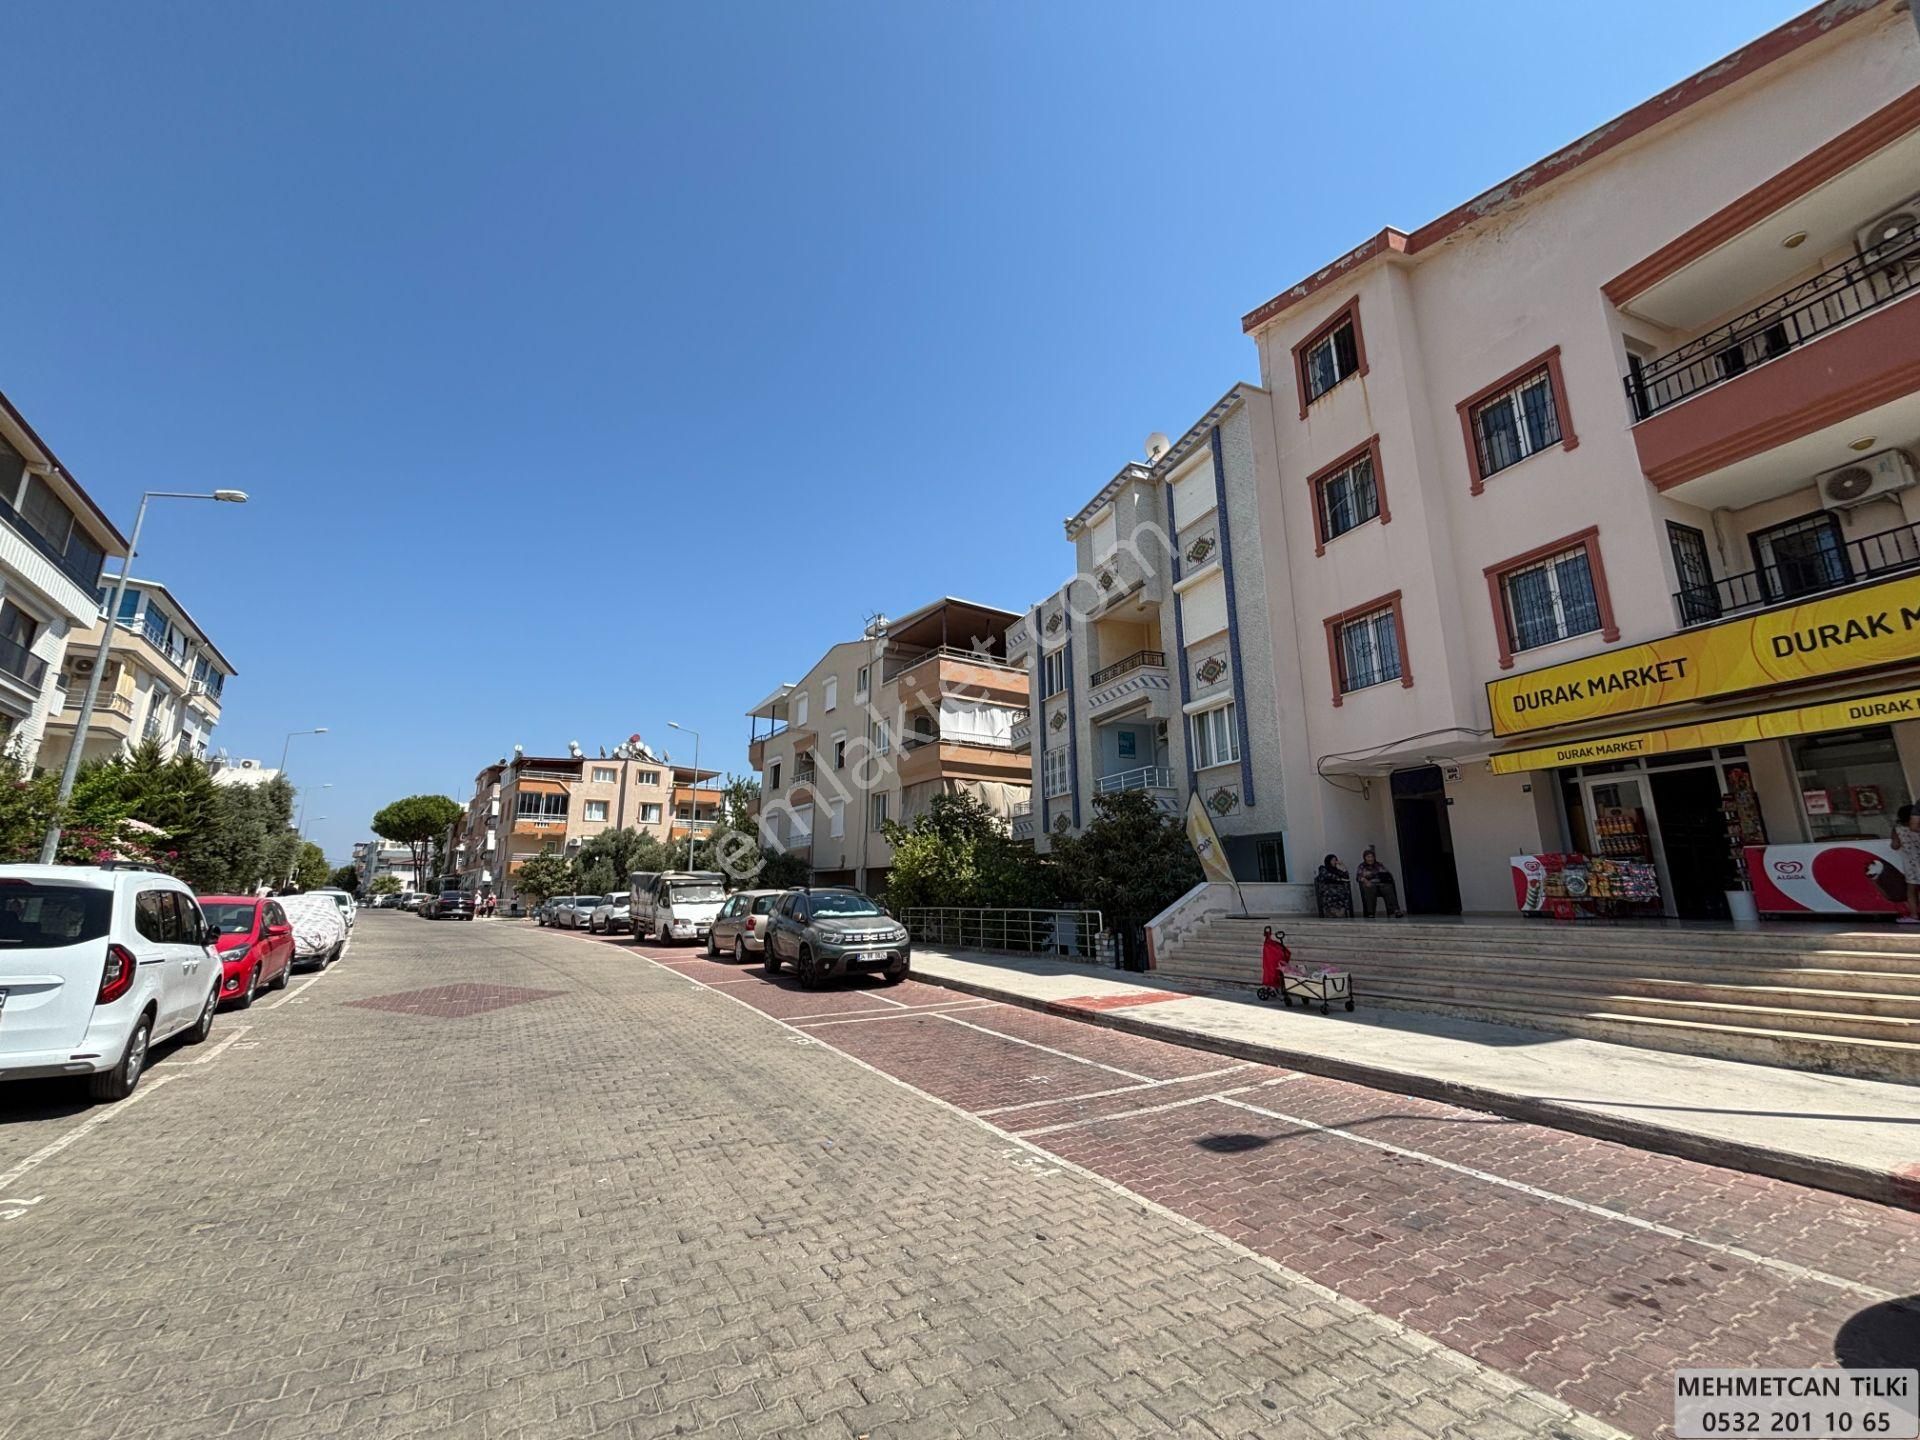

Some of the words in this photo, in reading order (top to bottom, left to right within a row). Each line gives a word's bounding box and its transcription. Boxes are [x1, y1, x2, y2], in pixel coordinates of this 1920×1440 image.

[1772, 611, 1895, 658] DURAK
[1512, 681, 1584, 713] DURAK
[1587, 657, 1688, 697] MARKET
[1849, 699, 1913, 719] DURAK
[1557, 746, 1595, 761] DURAK
[1596, 739, 1644, 755] MARKET
